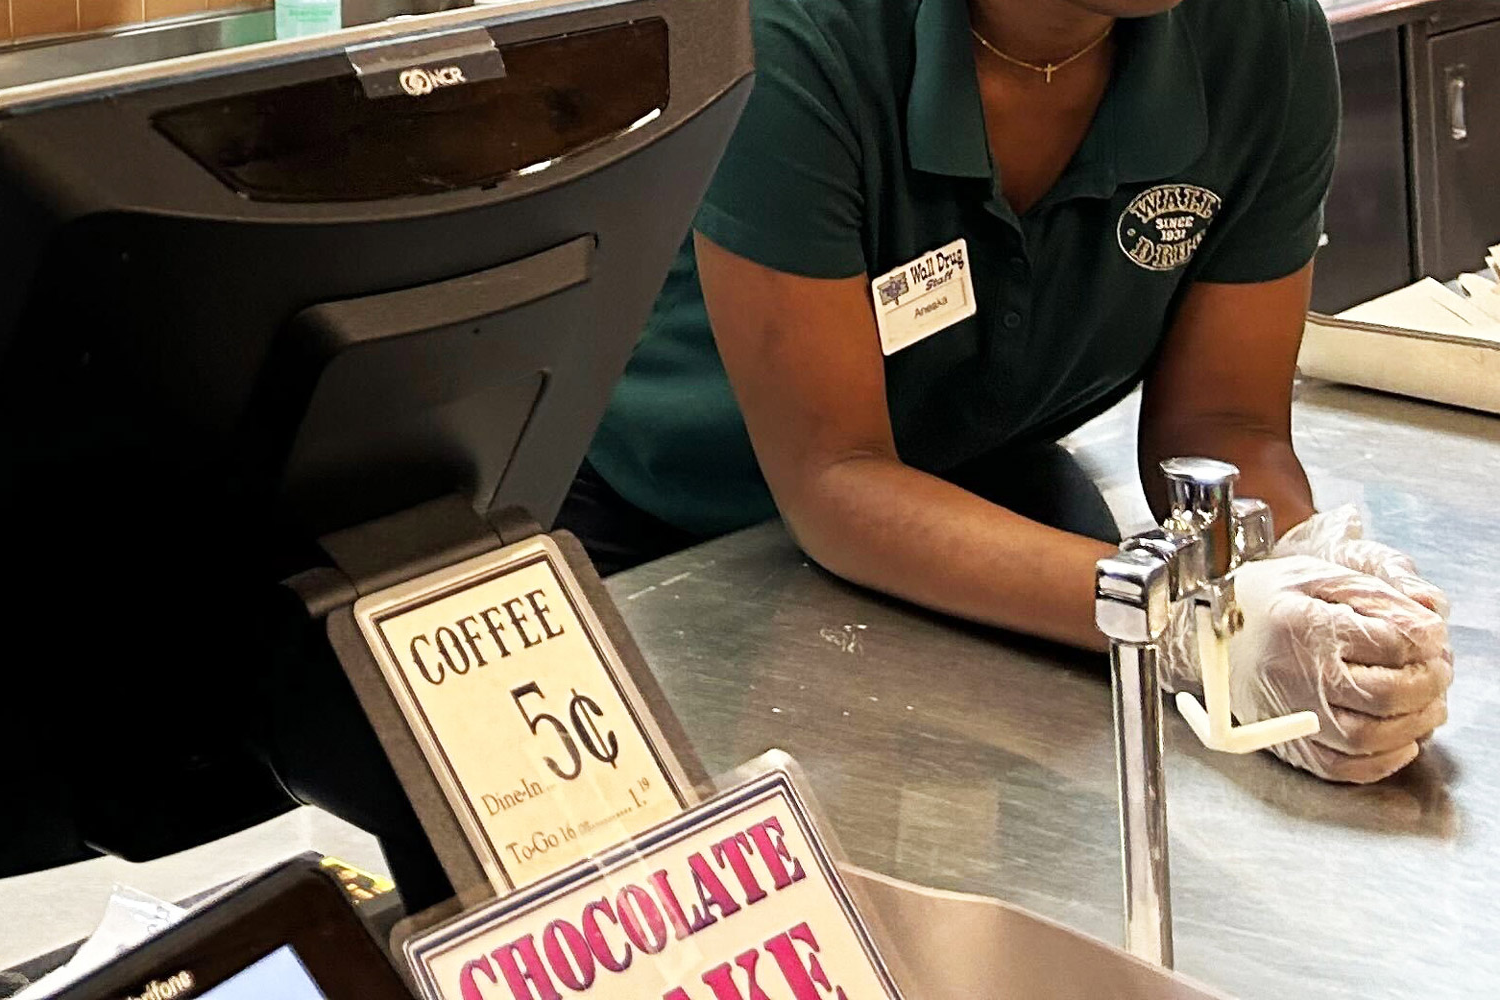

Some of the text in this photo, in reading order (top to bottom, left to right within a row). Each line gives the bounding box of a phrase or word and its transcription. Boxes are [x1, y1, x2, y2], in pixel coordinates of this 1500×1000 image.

[427, 66, 467, 88] NCR
[1128, 187, 1217, 224] WALL
[1155, 216, 1194, 230] SINCE
[909, 249, 965, 285] Wall Drug
[925, 269, 953, 291] Staff
[410, 589, 565, 685] COFFEE
[510, 681, 619, 781] 5¢
[481, 779, 544, 816] Dine-In
[505, 831, 559, 864] To-Go
[560, 823, 577, 841] 16
[459, 816, 807, 1000] CHOCOLATE
